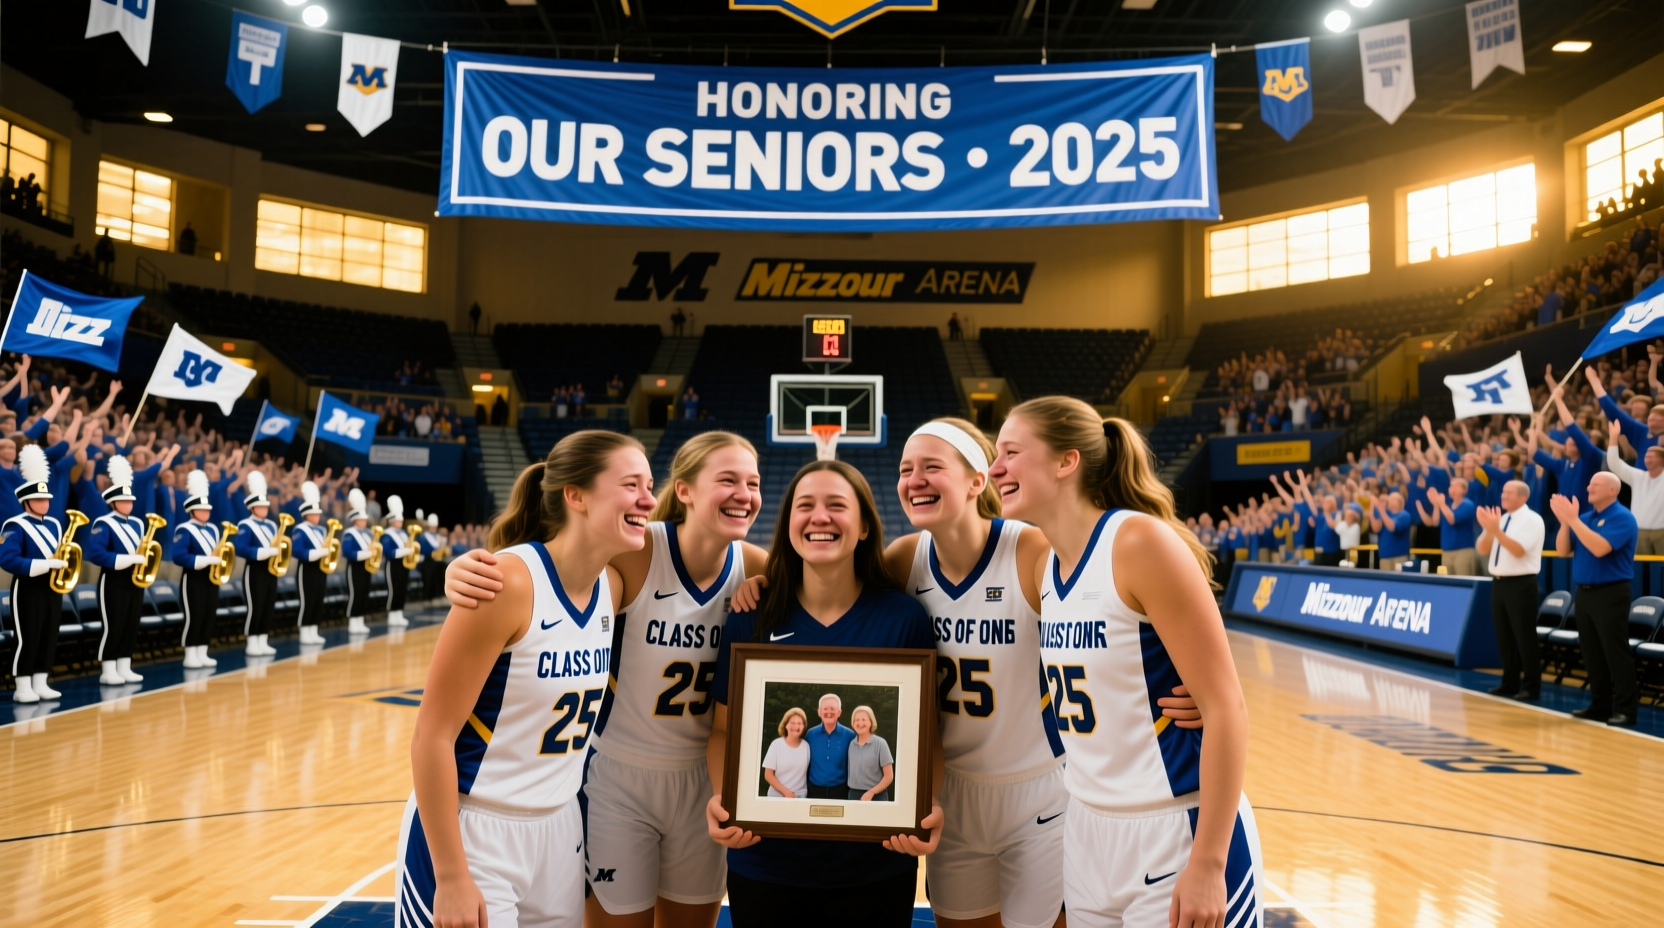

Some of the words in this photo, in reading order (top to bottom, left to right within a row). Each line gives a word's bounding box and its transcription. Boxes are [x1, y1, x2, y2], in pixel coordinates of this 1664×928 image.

[697, 80, 952, 120] HONORING
[481, 115, 624, 185] OUR
[643, 127, 945, 192] SENIORS
[1009, 116, 1180, 188] 2025
[615, 251, 720, 301] M
[741, 262, 904, 298] Mizzour
[915, 268, 1021, 295] ARENA
[323, 408, 366, 441] M
[1300, 581, 1373, 624] Mizzour
[1370, 591, 1432, 635] ARENA
[645, 619, 706, 649] CLASS
[709, 625, 725, 649] O
[955, 618, 976, 644] OF
[537, 649, 591, 679] CLASS
[653, 660, 720, 719] 25
[937, 655, 996, 719] 25
[1047, 664, 1098, 735] 25
[537, 687, 604, 757] 25
[593, 868, 617, 882] M
